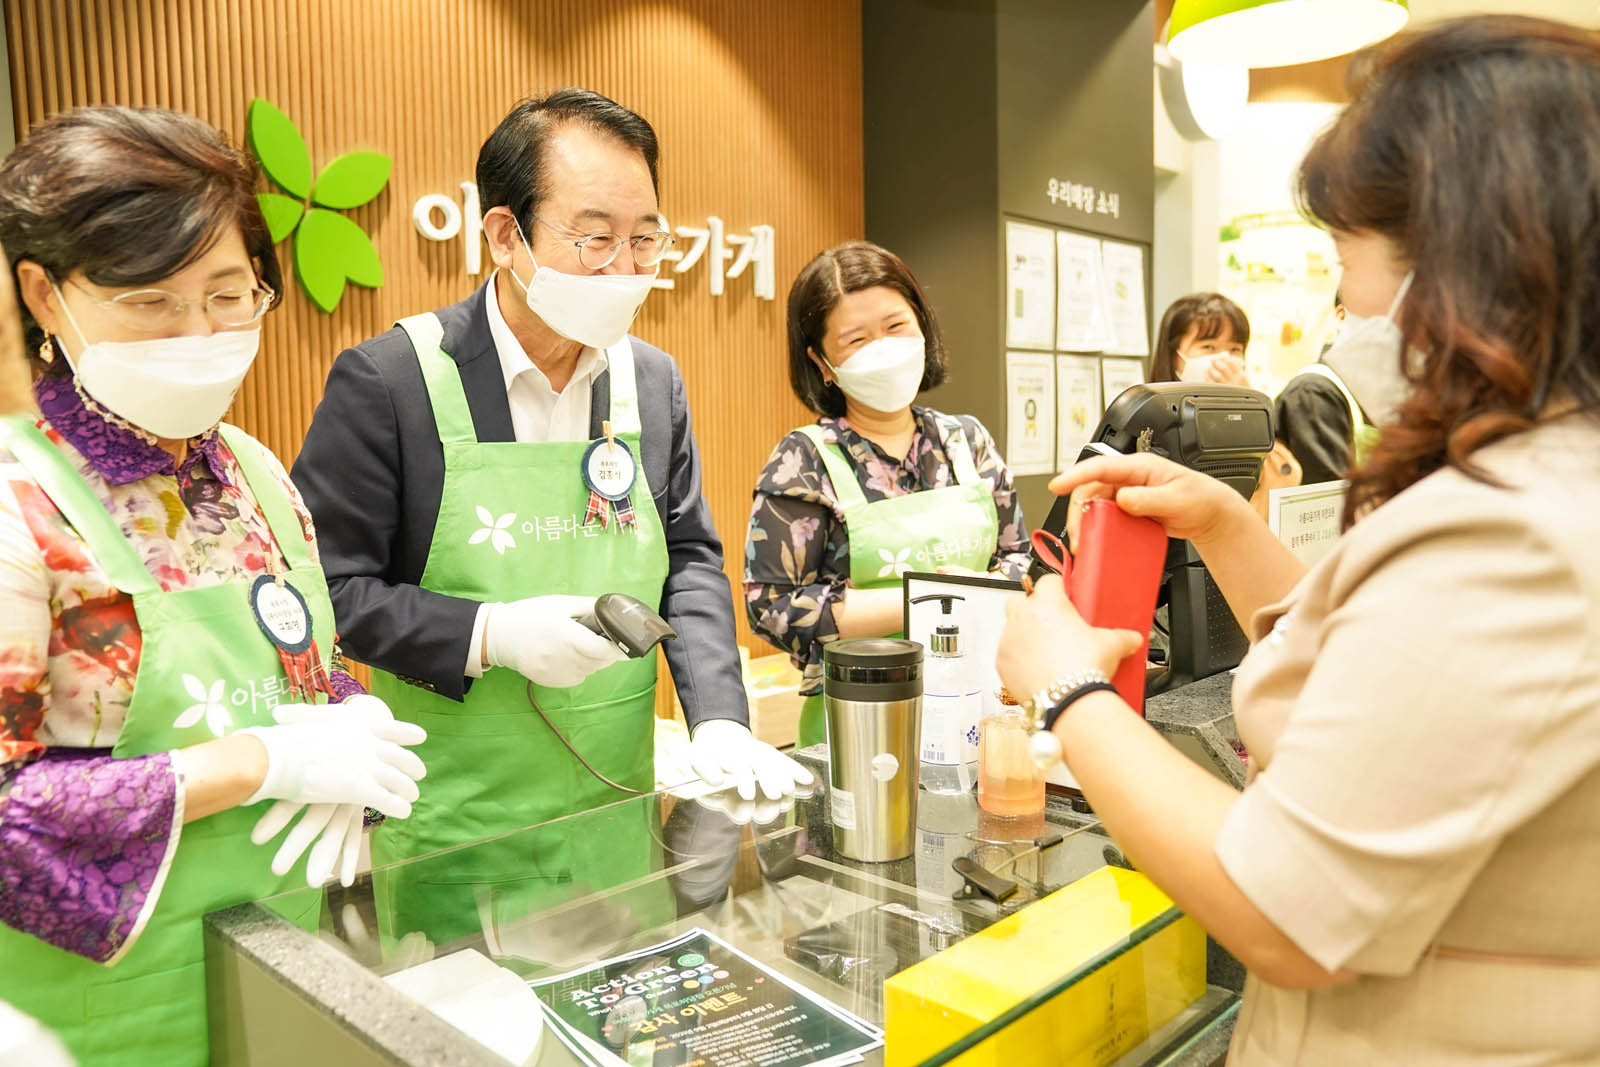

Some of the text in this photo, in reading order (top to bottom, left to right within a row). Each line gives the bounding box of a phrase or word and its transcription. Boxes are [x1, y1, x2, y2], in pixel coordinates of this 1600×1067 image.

[571, 965, 676, 1001] Action
[576, 993, 620, 1010] To
[624, 963, 719, 995] Green
[629, 1012, 680, 1035] 감사
[680, 992, 748, 1017] 이벤트
